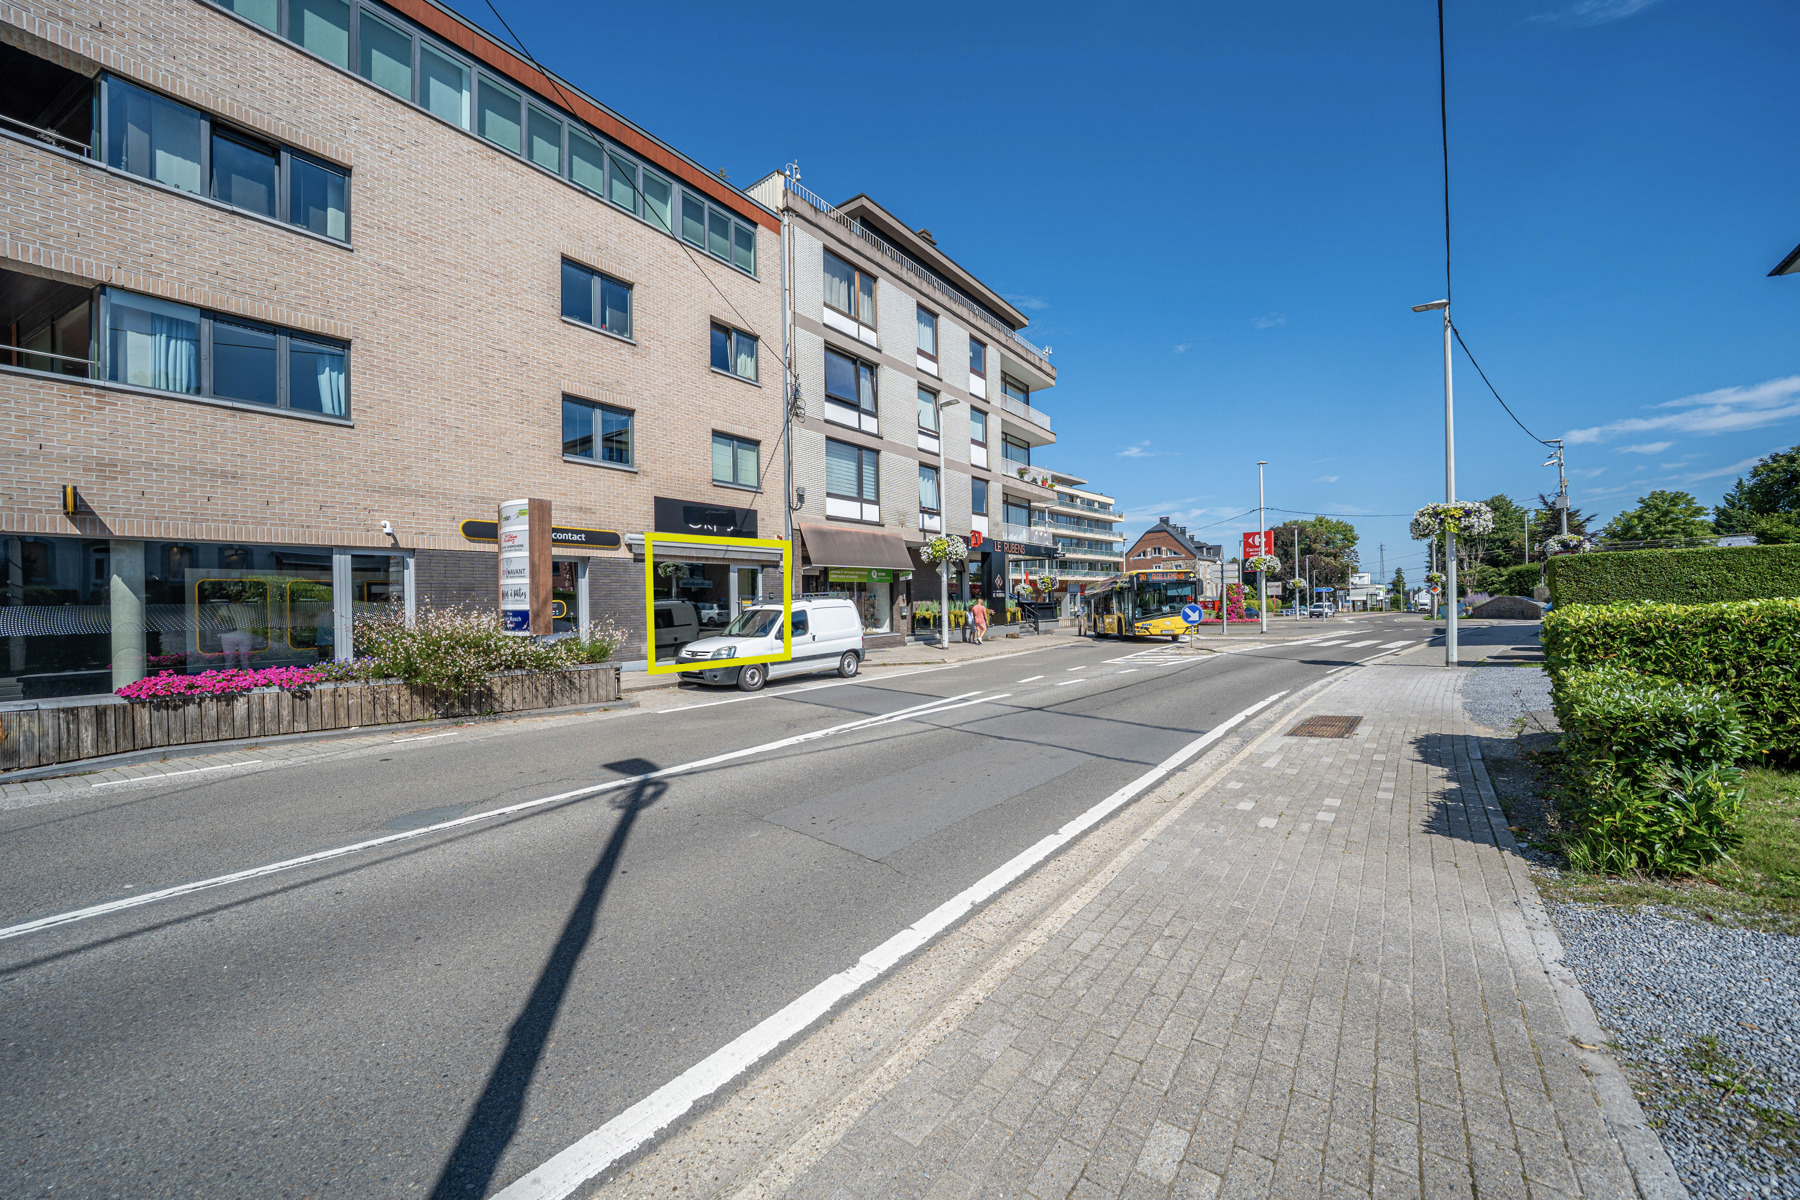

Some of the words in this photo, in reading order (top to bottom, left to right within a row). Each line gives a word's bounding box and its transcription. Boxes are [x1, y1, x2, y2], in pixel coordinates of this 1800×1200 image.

[552, 532, 586, 541] contact
[994, 541, 1001, 552] LE
[1003, 542, 1026, 555] RUBENS
